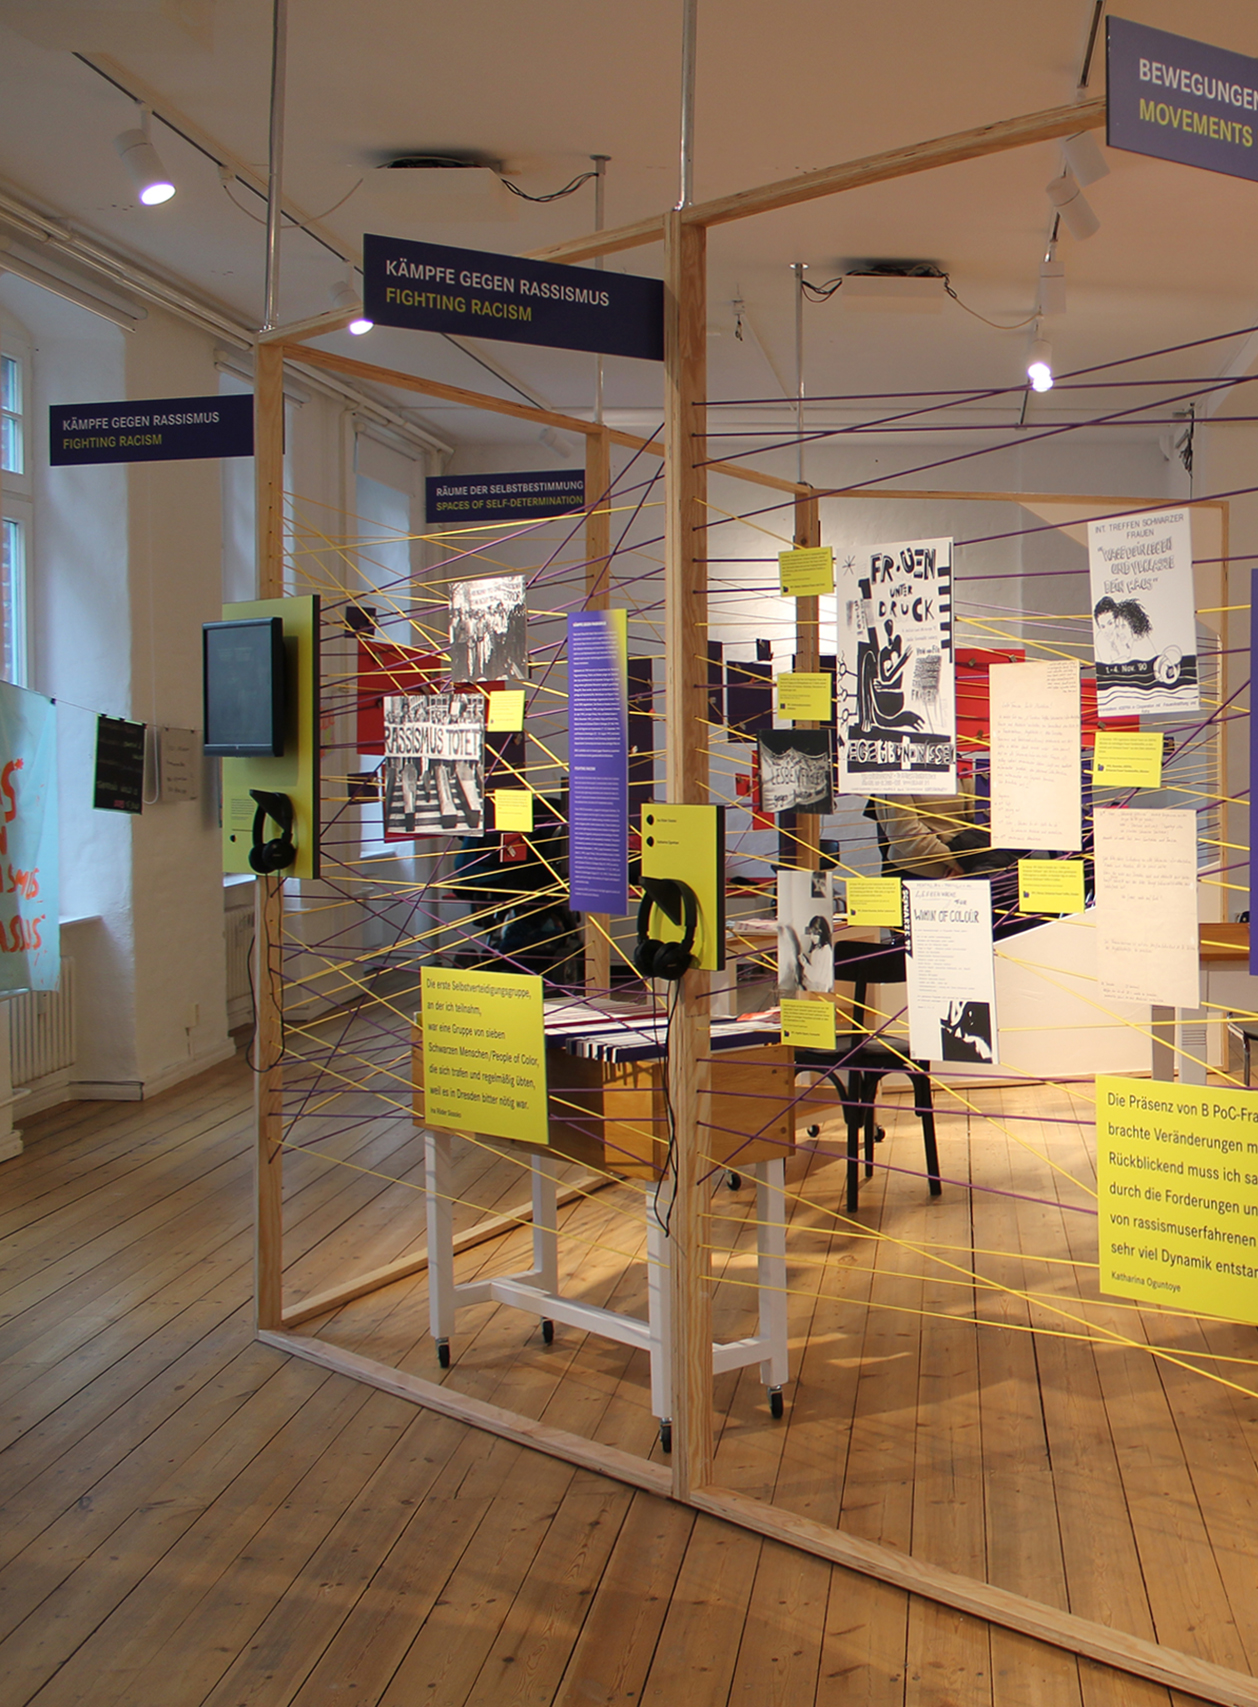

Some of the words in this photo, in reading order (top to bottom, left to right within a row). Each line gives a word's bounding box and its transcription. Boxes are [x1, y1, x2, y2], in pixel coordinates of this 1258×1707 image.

[1140, 98, 1252, 147] MOVEMENTS
[386, 258, 454, 284] KÄMPFE
[460, 271, 514, 293] GEGEN
[521, 280, 609, 306] RASSISMUS
[386, 287, 465, 313] FIGHTING
[472, 299, 531, 321] RACISM
[63, 417, 108, 431] KÄMPFE
[112, 416, 149, 428] GEGEN
[153, 412, 219, 426] RASSISMUS
[63, 436, 116, 449] FIGHTING
[119, 434, 162, 447] RACISM
[437, 485, 467, 496] RÄUME
[470, 486, 488, 495] DER
[490, 480, 583, 493] SELBSTBESTIMMUNG
[436, 502, 469, 511] SPACES
[472, 501, 483, 509] OF
[486, 495, 582, 508] SELF-DETERMINATION
[1109, 520, 1140, 531] TREFFEN
[1142, 514, 1184, 526] SCHWARZER
[1127, 529, 1154, 539] FRAUEN
[890, 583, 912, 598] UNTER
[879, 597, 934, 622] DRUCK
[384, 726, 444, 754] RASSISMUS
[427, 978, 435, 989] Die
[437, 981, 450, 990] erste
[452, 980, 531, 999] Selbstverteidigungsgruppe,
[440, 1024, 450, 1034] eine
[452, 1024, 472, 1038] Gruppe
[475, 1029, 484, 1037] von
[486, 1030, 505, 1039] sieben
[428, 1042, 458, 1055] Schwarzen
[514, 1054, 520, 1064] of
[521, 1054, 539, 1068] Color,
[429, 1064, 437, 1074] die
[439, 1065, 450, 1075] sich
[452, 1066, 468, 1079] trafen
[470, 1071, 480, 1080] und
[516, 1075, 535, 1090] übten,
[1108, 1092, 1125, 1107] Die
[1130, 1095, 1173, 1113] Präsenz
[1177, 1103, 1197, 1116] von
[1202, 1103, 1209, 1117] B
[1108, 1122, 1150, 1139] brachte
[1154, 1128, 1243, 1153] Veränderungen
[1109, 1152, 1184, 1175] Rückblickend
[1188, 1165, 1219, 1180] muss
[1223, 1166, 1240, 1182] ich
[1109, 1182, 1141, 1198] durch
[1145, 1187, 1161, 1201] die
[1165, 1190, 1239, 1215] Forderungen
[1110, 1213, 1129, 1225] von
[1133, 1216, 1256, 1247] rassismuserfahrenen
[1111, 1242, 1134, 1257] sehr
[1138, 1245, 1157, 1260] viel
[1162, 1249, 1212, 1271] Dynamik
[1112, 1271, 1145, 1285] Katharina
[1147, 1277, 1180, 1292] Oguntoye
